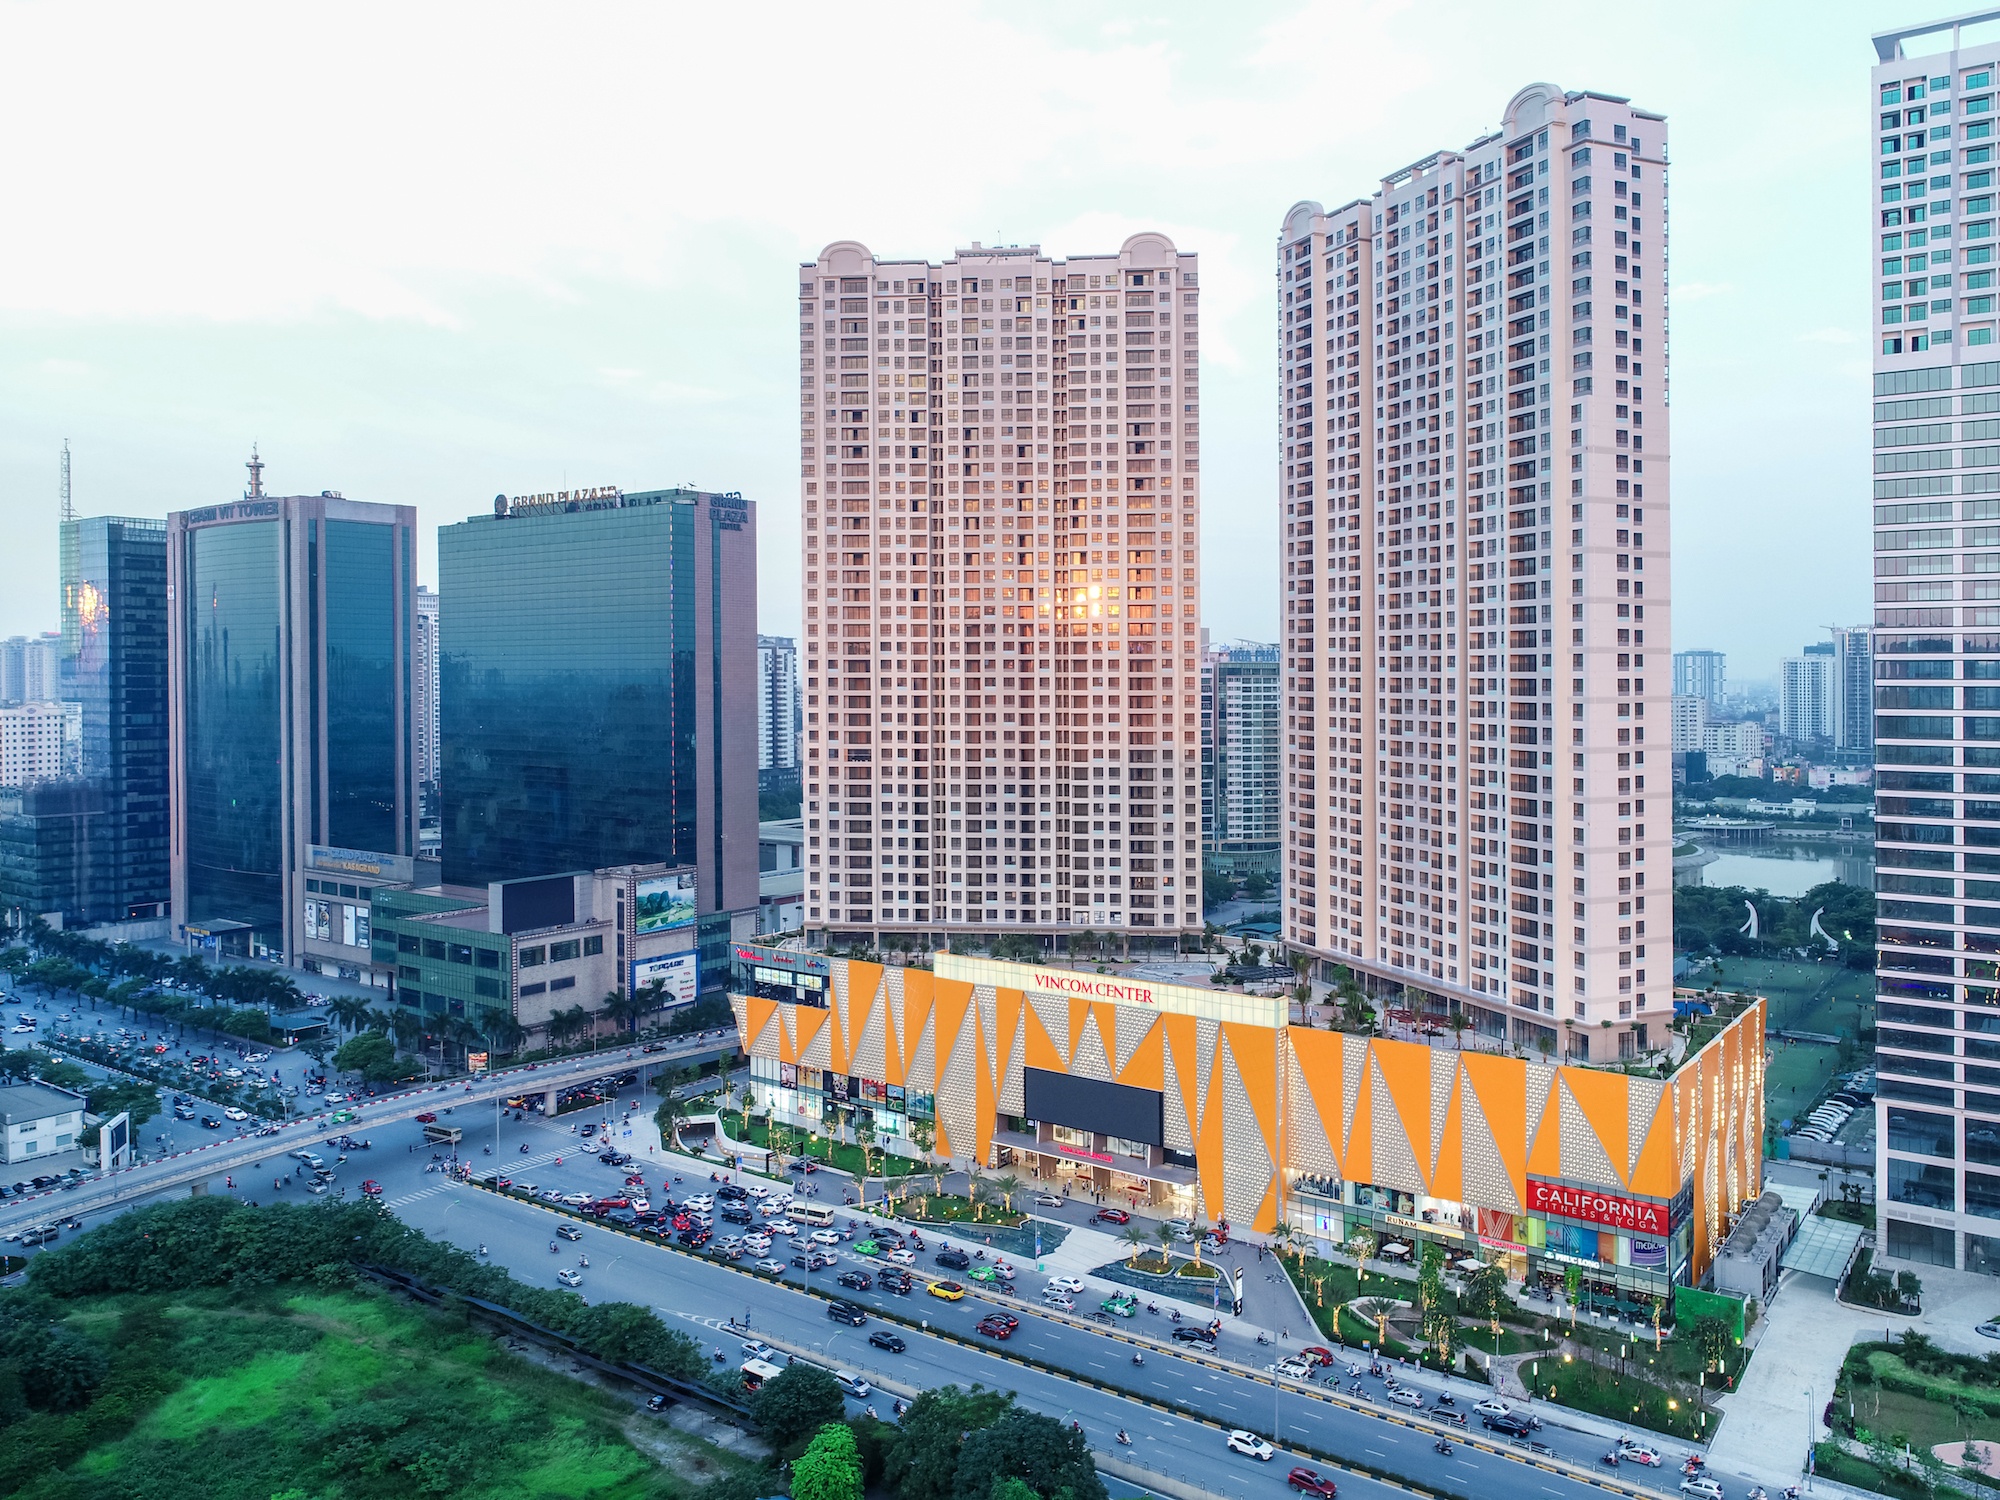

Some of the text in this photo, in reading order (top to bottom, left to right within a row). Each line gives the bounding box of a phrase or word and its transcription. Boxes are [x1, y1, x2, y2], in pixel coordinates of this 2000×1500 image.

[513, 493, 555, 508] GRAND
[558, 487, 598, 502] PLAZA
[710, 497, 748, 510] GRAND
[190, 501, 279, 524] CHARM VIT TOWER
[710, 508, 748, 523] PLAZA
[330, 849, 354, 860] GRAND
[355, 852, 378, 864] PLAZA
[1035, 974, 1155, 1004] VINCOM CENTER
[1536, 1187, 1658, 1222] CALIFORNIA
[1536, 1200, 1659, 1231] FITNESS & YOGA
